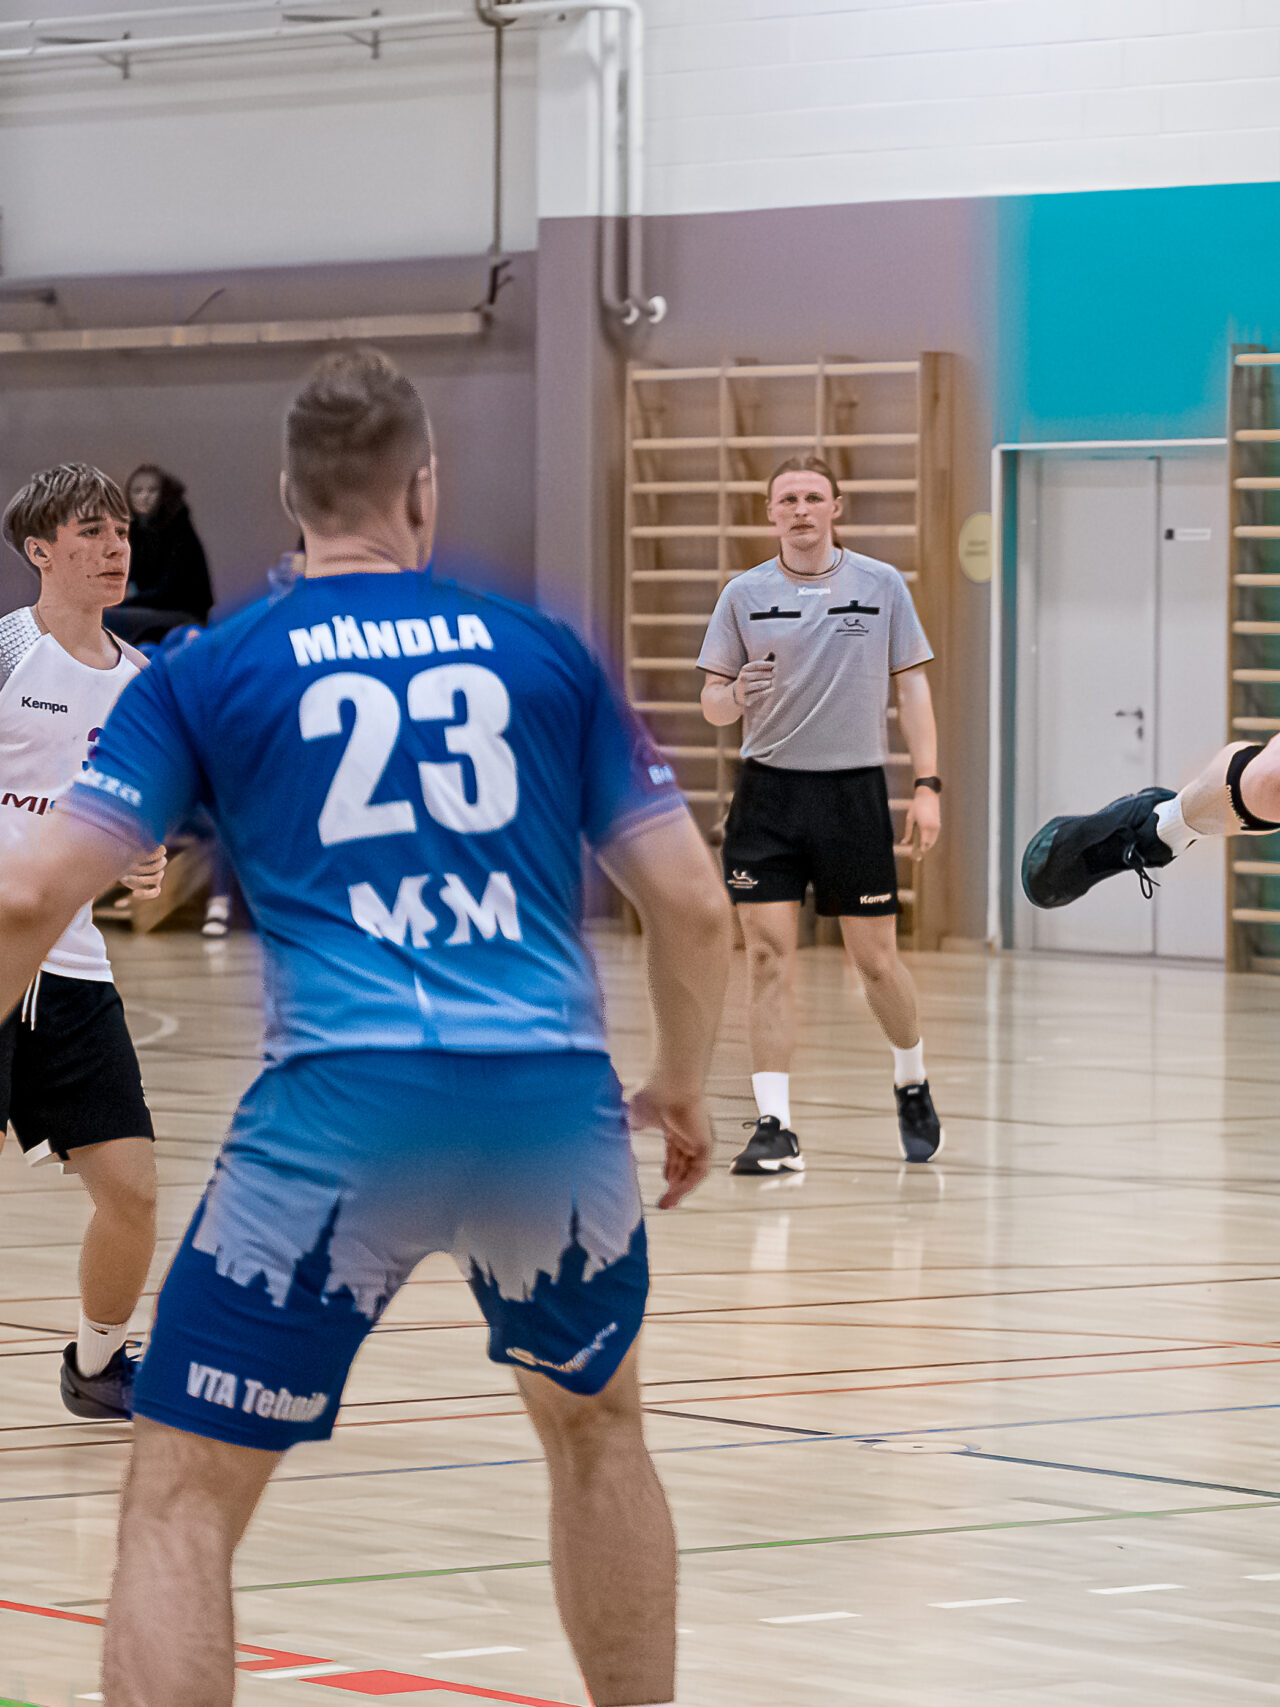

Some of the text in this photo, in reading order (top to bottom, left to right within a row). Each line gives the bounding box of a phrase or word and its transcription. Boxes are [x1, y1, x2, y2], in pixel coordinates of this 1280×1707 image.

[288, 613, 494, 667] MÄNDLA
[21, 696, 68, 714] Kempa
[298, 662, 519, 848] 23
[1, 792, 56, 816] MI
[186, 1361, 237, 1409] VTA
